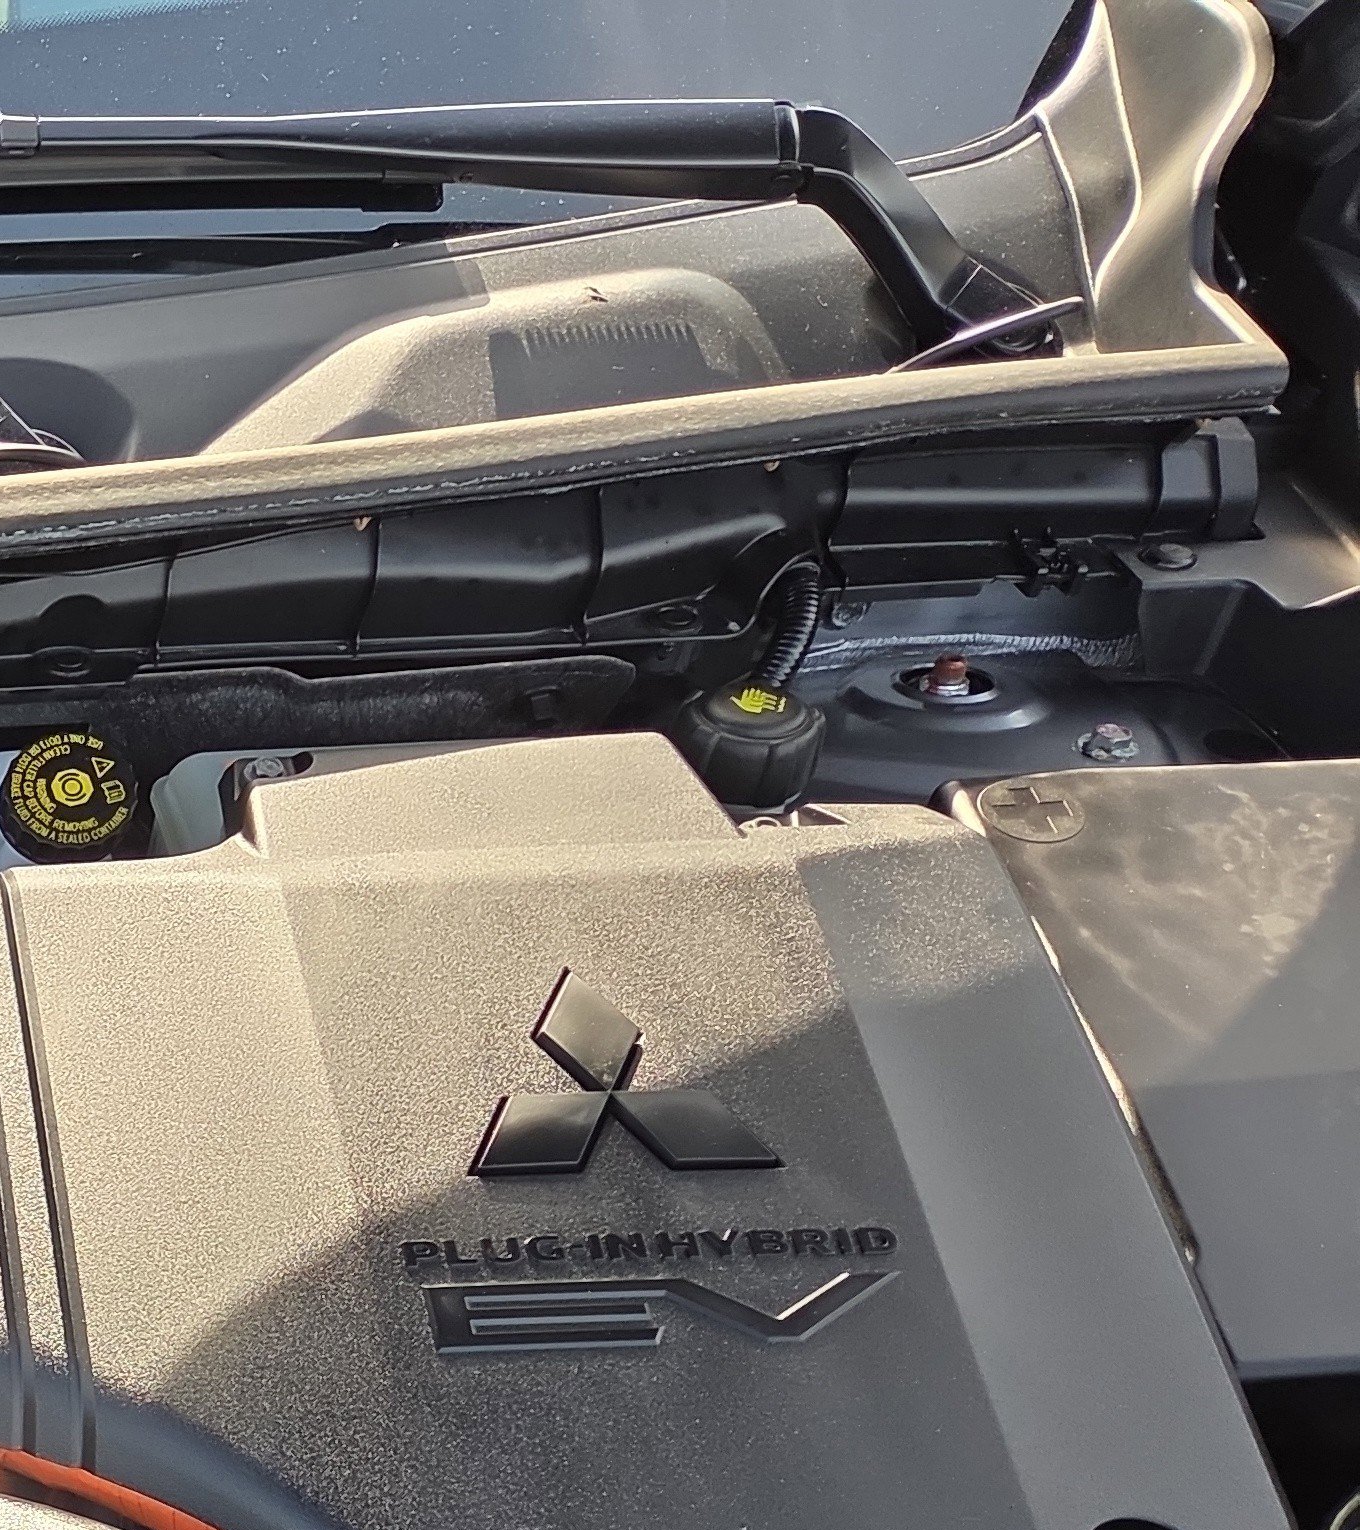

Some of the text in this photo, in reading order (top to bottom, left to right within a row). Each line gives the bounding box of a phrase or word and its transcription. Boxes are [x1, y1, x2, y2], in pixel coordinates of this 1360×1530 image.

[63, 734, 86, 745] ONLY
[87, 736, 104, 750] USE
[28, 744, 42, 757] OR
[10, 773, 23, 799] BRAKE
[23, 744, 99, 831] CLEAN FILLER CAP BEFORE REMOVING
[13, 798, 30, 821] FLUID
[27, 818, 50, 837] FROM
[90, 806, 129, 840] CONTAINER
[49, 831, 56, 841] A
[58, 832, 91, 844] SEALED
[400, 1226, 898, 1269] PLUG-IN HYBRID
[421, 1271, 900, 1354] EV
